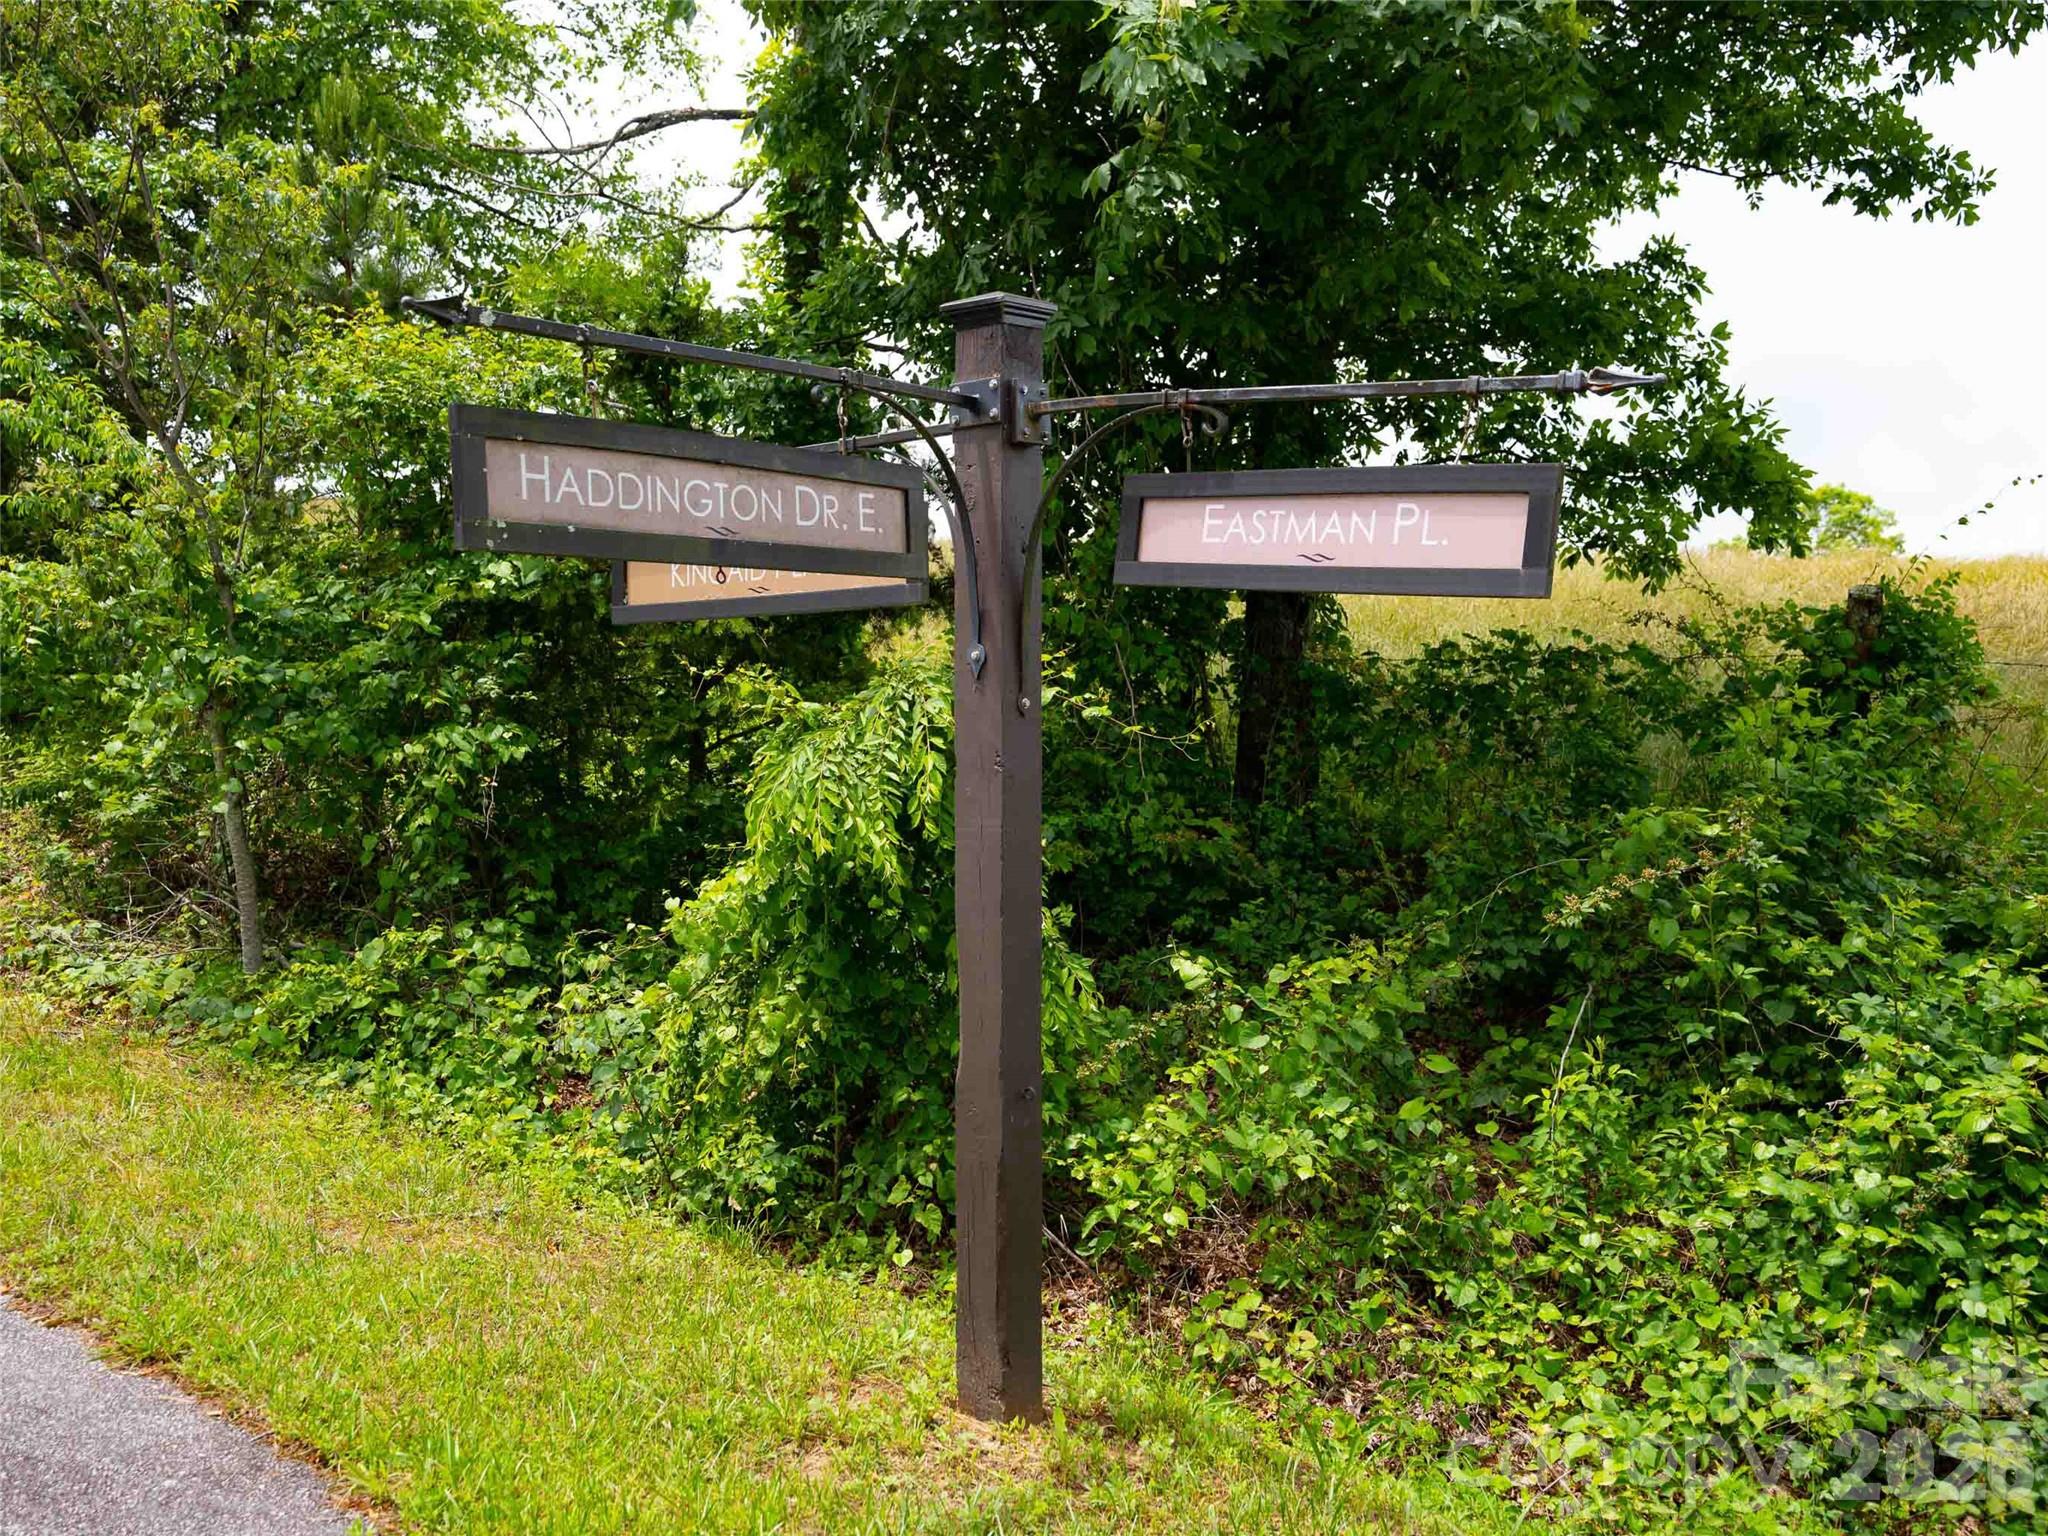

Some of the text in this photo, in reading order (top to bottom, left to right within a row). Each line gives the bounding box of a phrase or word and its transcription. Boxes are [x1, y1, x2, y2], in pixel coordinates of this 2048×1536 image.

[519, 453, 884, 534] HADDINGTON DR. E.
[1201, 502, 1449, 547] EASTMAN PL.
